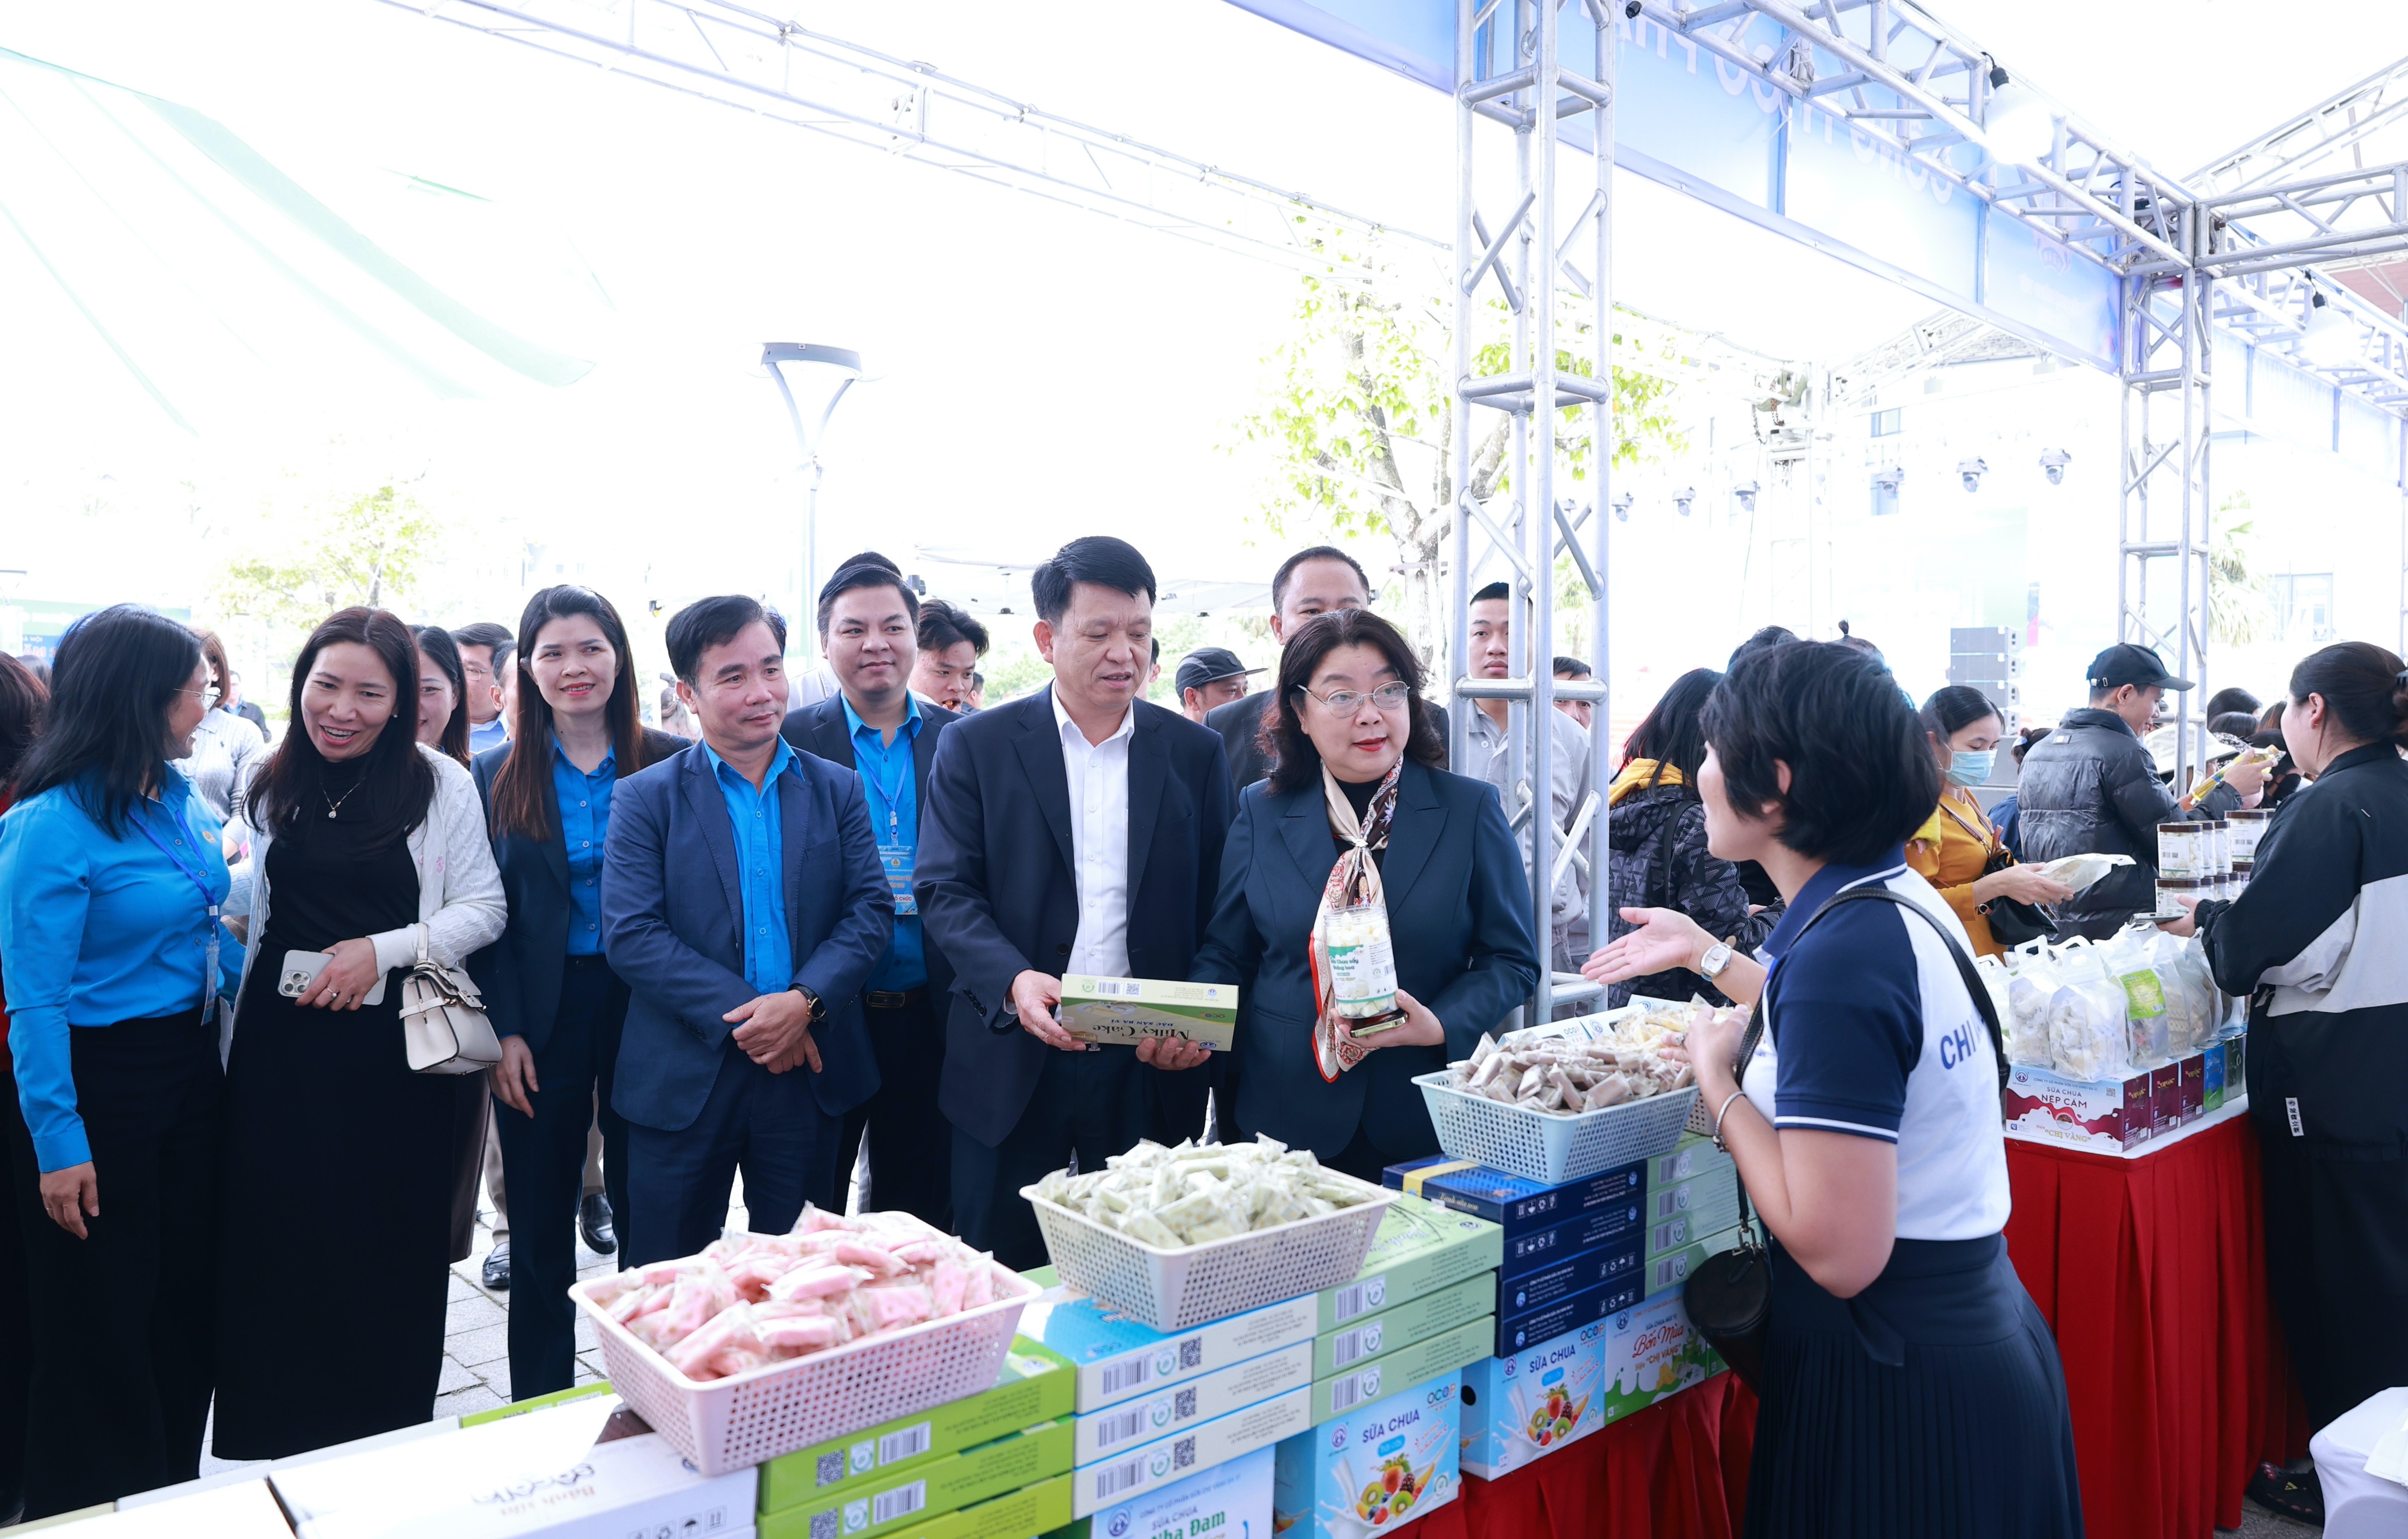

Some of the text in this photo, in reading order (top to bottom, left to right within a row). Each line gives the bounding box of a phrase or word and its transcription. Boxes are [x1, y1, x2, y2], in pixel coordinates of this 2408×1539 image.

[23, 643, 46, 657] ĂM
[1093, 1025, 1191, 1040] Milky Cake
[2042, 1094, 2061, 1103] NẾP
[1580, 1323, 1605, 1341] OCOP
[1632, 1323, 1684, 1358] Bốn Mùa
[1529, 1344, 1576, 1373] SỮA CHUA
[1427, 1383, 1457, 1404] OCOP
[1362, 1409, 1420, 1443] SỮA CHUA
[1139, 1507, 1155, 1519] CÔNG
[1152, 1505, 1198, 1530] SỮA CHUA
[1189, 1511, 1226, 1537] Đam
